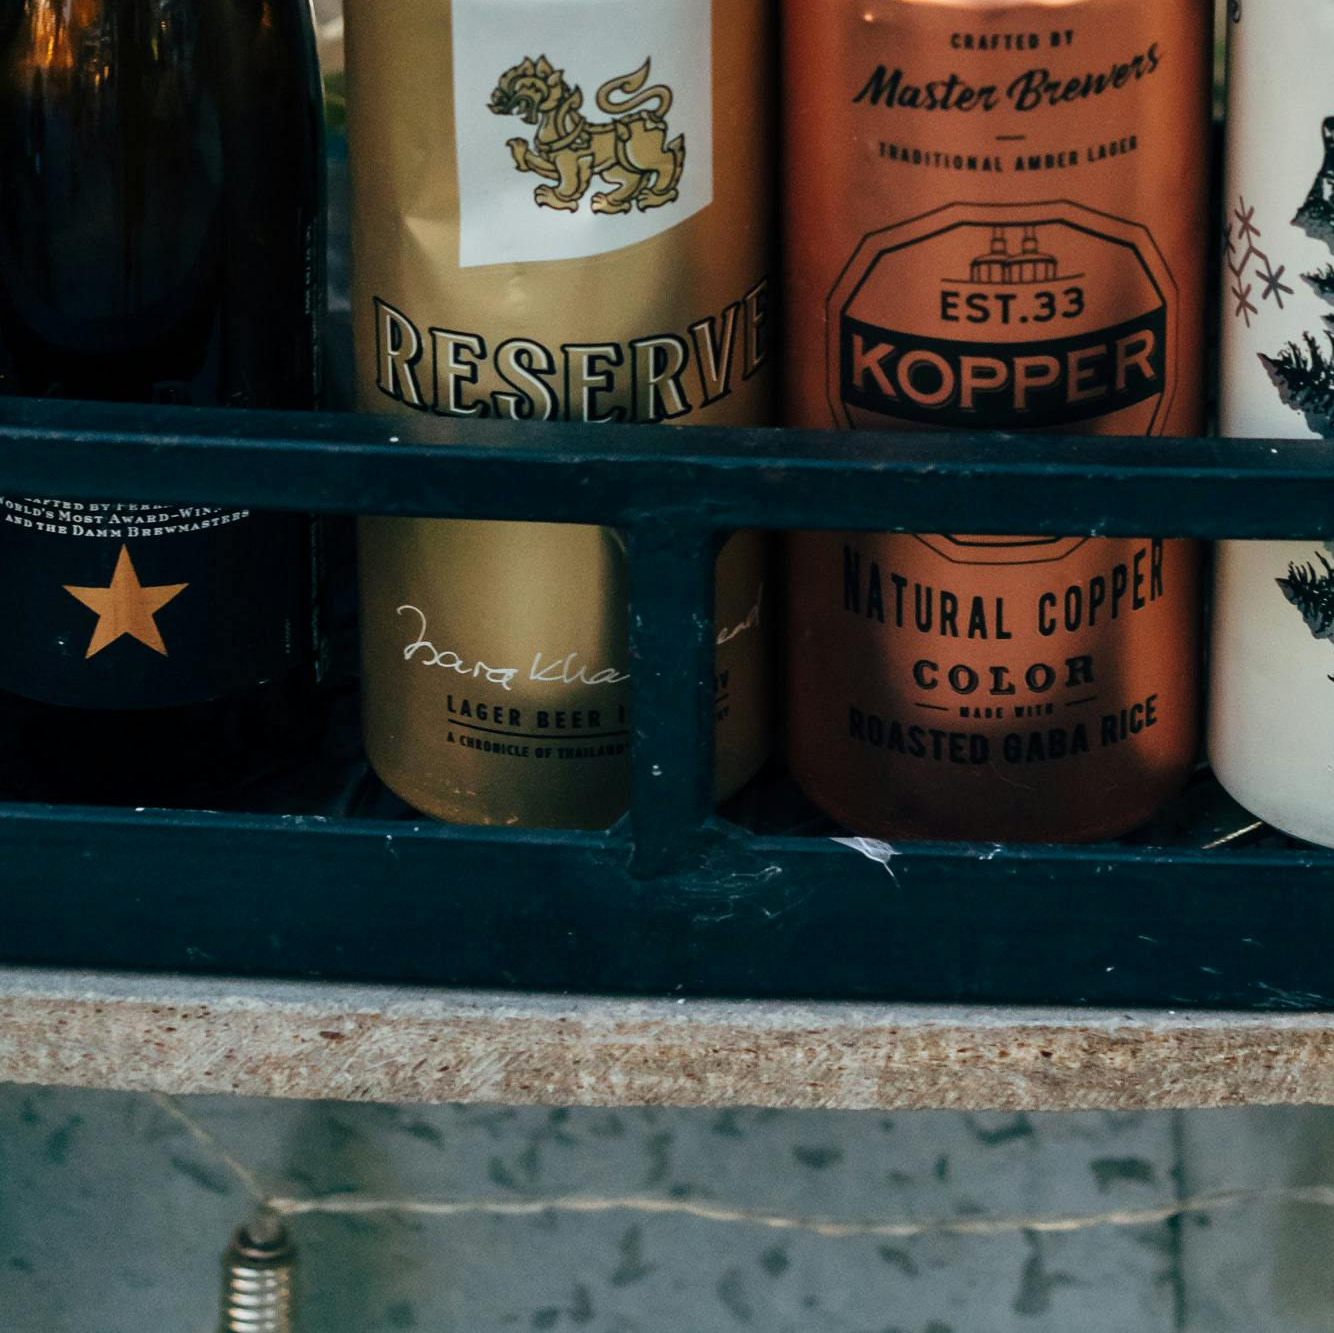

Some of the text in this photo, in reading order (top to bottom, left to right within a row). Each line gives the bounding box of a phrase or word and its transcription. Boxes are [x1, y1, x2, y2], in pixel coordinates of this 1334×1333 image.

[949, 28, 1075, 51] CRAFTED BY
[851, 41, 1161, 113] Master Brewers
[878, 134, 1139, 174] TRADITIONAL AMBER LAGER
[940, 285, 1087, 325] EST.33
[372, 276, 769, 423] RESERVE
[850, 327, 1157, 413] KOPPER
[5, 508, 251, 538] AND THE DAMM BREWMASTERS
[841, 540, 1014, 641] NATURAL
[1036, 537, 1166, 638] COPPER
[912, 654, 1097, 697] COLOR
[446, 693, 601, 731] LAGER BEER
[848, 692, 1159, 766] ROASTED GABA RICE
[958, 701, 1055, 720] MADE WITH
[459, 734, 530, 758] CHRONICLE
[535, 746, 553, 759] OF
